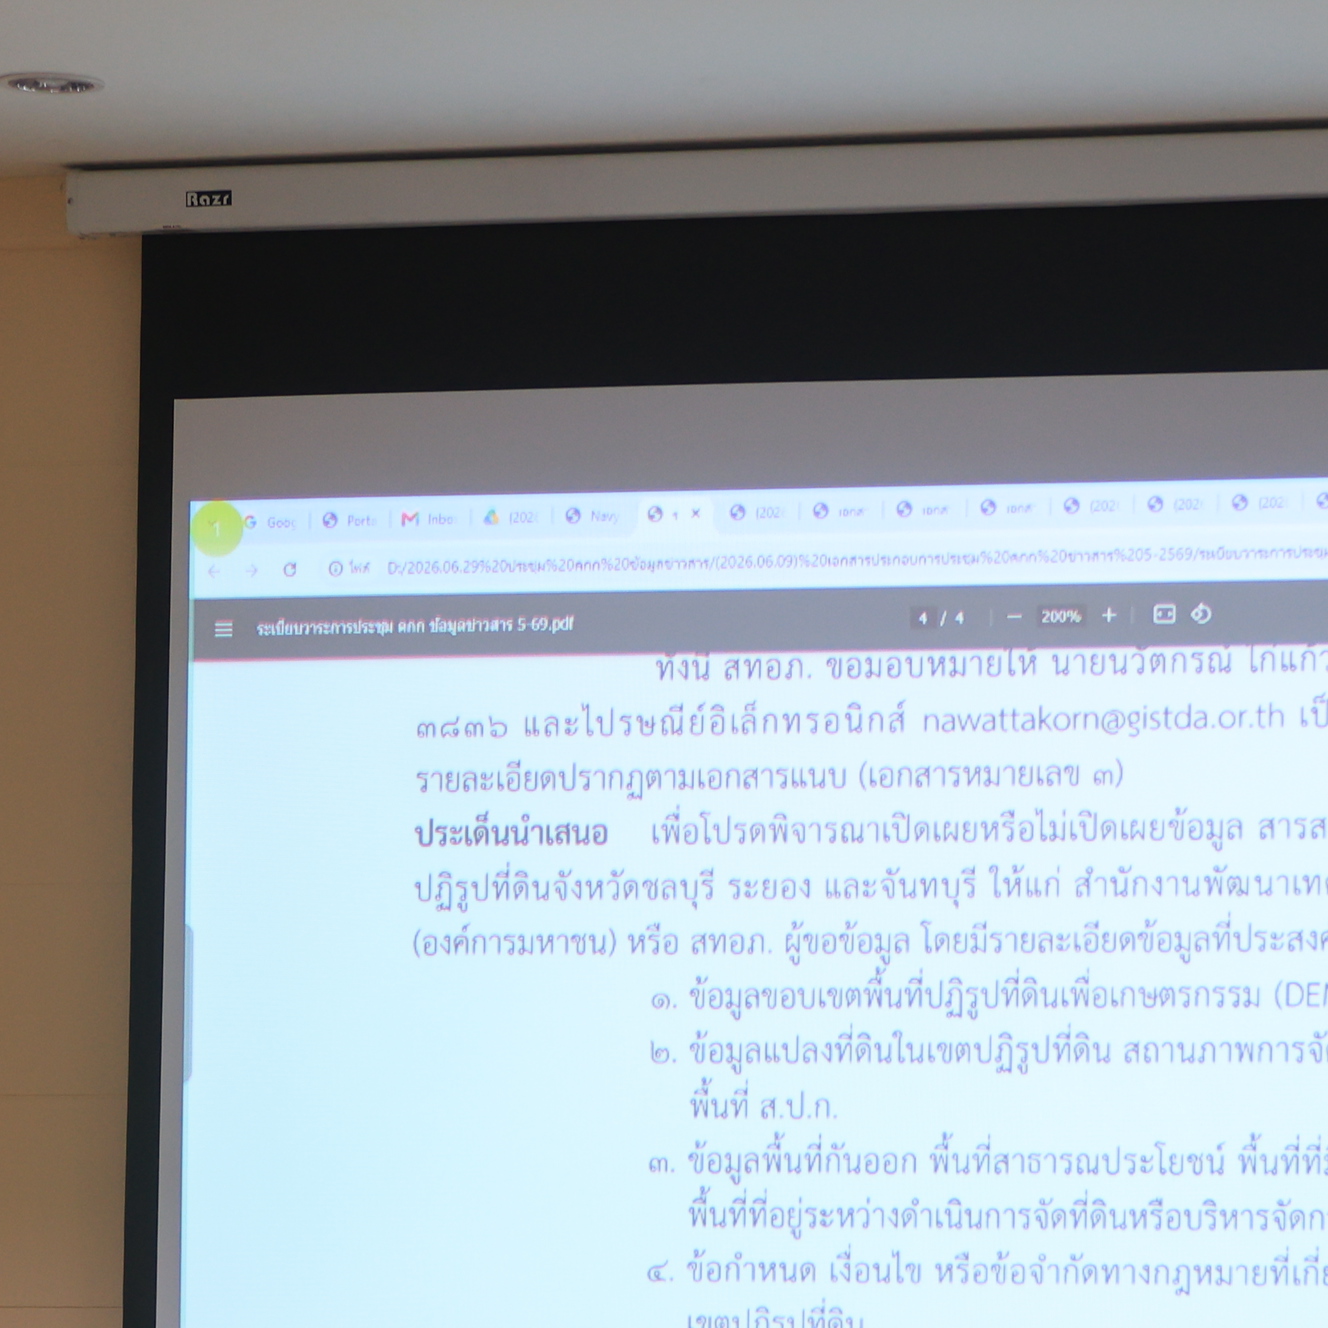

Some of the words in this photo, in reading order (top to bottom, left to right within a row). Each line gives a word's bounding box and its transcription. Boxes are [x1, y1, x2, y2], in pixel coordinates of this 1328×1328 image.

[1041, 608, 1082, 625] 200%
[724, 657, 812, 682] สทอภ.
[416, 714, 508, 740] ๓๘๓๖
[523, 699, 906, 740] และไปรษณีย์อิเล็กทรอนิกส์
[923, 702, 1285, 739] nawattakorn@gistda.or.th
[415, 759, 847, 801] รายละเอียดปรากฏตามเอกสารแนบ
[858, 759, 1080, 794] (เอกสารหมายเลข
[1092, 758, 1124, 790] ๓)
[413, 808, 609, 850] ประเด็นนำเสนอ
[651, 804, 1244, 853] เพื่อโปรดพิจารณาเปิดเผยหรือไม่เปิดเผยข้อมูล
[413, 861, 715, 914] ปฏิรูปที่ดินจังหวัดชลบุรี
[727, 877, 811, 901] ระยอง
[825, 865, 977, 910] และจันทบุรี
[987, 864, 1061, 900] ให้แก่
[412, 922, 617, 959] (องค์การมหาชน)
[627, 922, 679, 956] หรือ
[690, 931, 773, 956] สทอภ.
[784, 917, 910, 967] ผู้ขอข้อมูล
[650, 991, 679, 1011] ๑.
[688, 967, 1261, 1022] ข้อมูลขอบเขตพื้นที่ปฏิรูปที่ดินเพื่อเกษตรกรรม
[650, 1039, 678, 1066] ๒.
[688, 1023, 1112, 1076] ข้อมูลแปลงที่ดินในเขตปฏิรูปที่ดิน
[689, 1076, 749, 1120] พื้นที่
[760, 1089, 839, 1121] ส.ป.ก.
[648, 1156, 676, 1175] ๓.
[687, 1131, 917, 1186] ข้อมูลพื้นที่กันออก
[928, 1131, 1225, 1177] พื้นที่สาธารณประโยชน์
[646, 1259, 675, 1284] ๔.
[686, 1248, 817, 1284] ข้อกำหนด
[829, 1243, 922, 1285] เงื่อนไข
